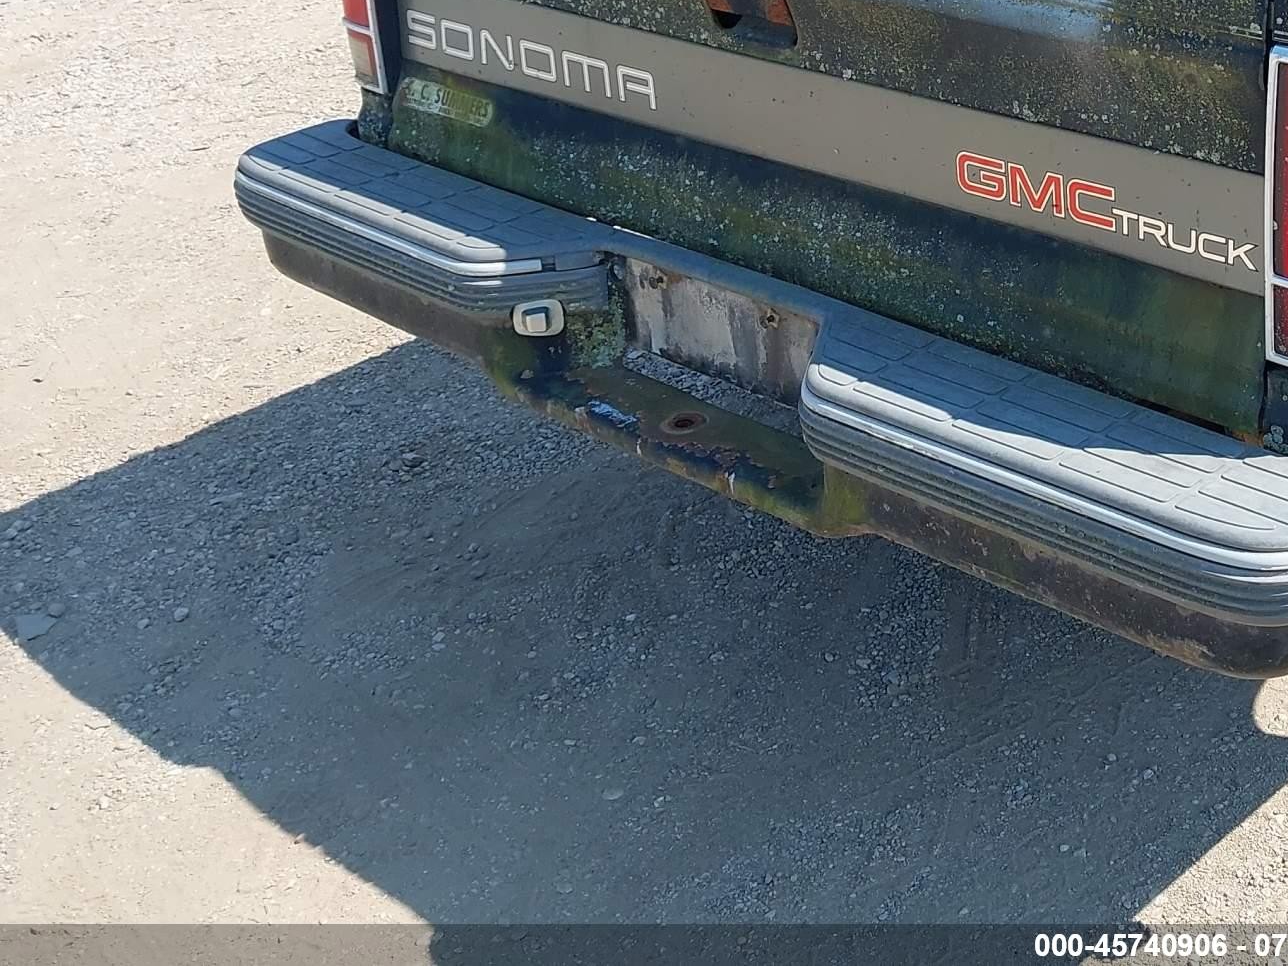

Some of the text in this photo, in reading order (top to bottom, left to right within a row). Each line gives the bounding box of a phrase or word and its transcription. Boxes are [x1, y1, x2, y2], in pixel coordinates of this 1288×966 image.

[406, 9, 657, 110] SONOMA
[956, 151, 1259, 272] GMC TRUCK
